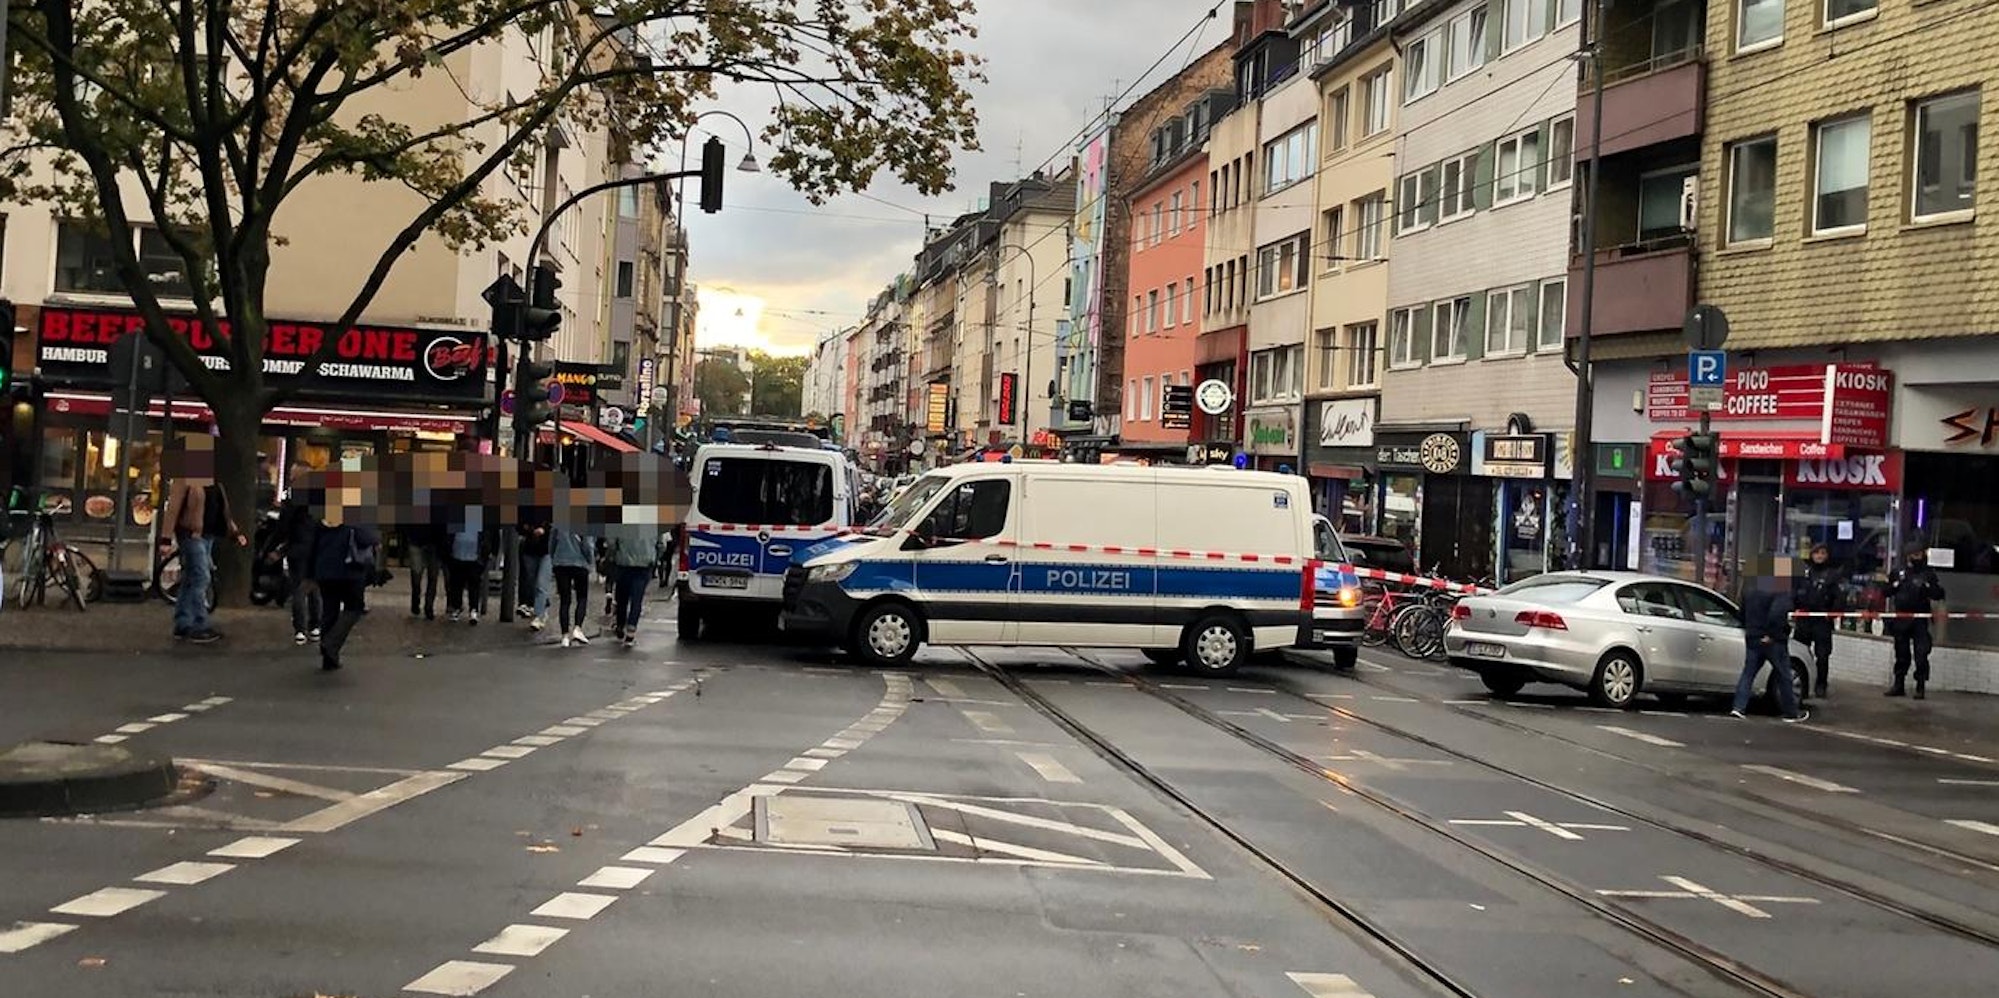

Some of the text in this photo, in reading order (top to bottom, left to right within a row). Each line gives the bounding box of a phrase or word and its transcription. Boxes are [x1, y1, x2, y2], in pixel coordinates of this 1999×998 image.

[41, 346, 108, 363] HAMBUR
[338, 329, 418, 360] ONE
[1697, 356, 1717, 381] P
[1737, 370, 1769, 390] PICO
[1836, 371, 1888, 391] KIOSK
[1727, 395, 1777, 415] COFFEE
[1209, 448, 1229, 460] sky
[1740, 442, 1784, 455] Sandwiches
[1799, 443, 1827, 456] Coffee
[1797, 455, 1886, 486] KIOSK
[695, 551, 755, 567] POLIZEI
[1046, 569, 1131, 589] POLIZEI
